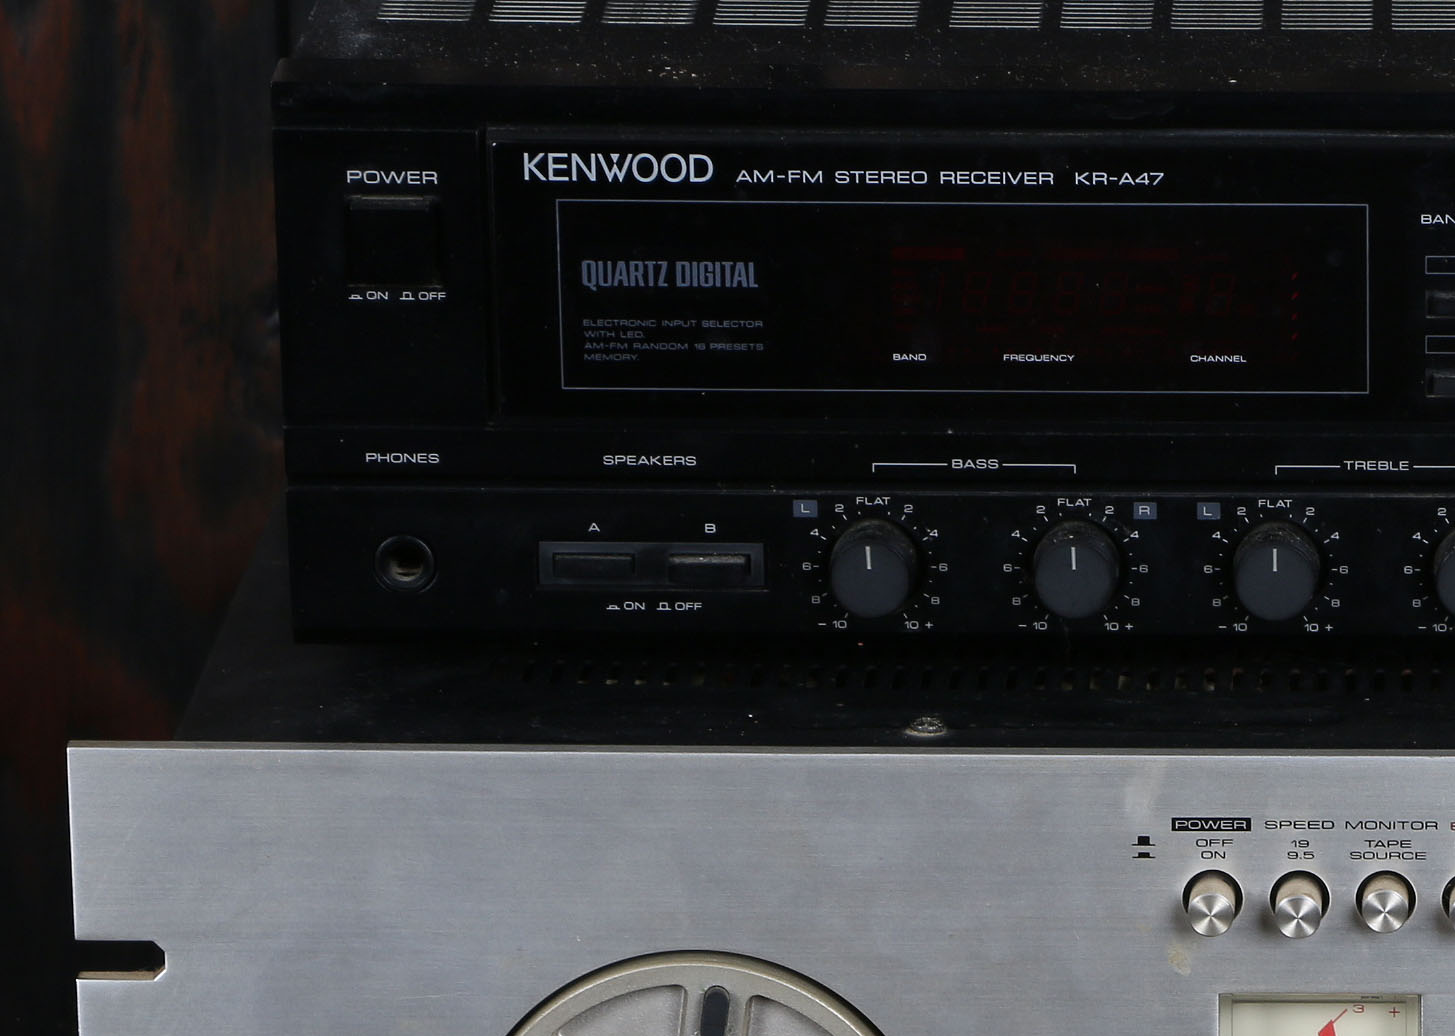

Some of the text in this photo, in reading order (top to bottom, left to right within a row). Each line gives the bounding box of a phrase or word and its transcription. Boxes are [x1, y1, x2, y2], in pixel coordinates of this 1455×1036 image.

[523, 152, 1165, 186] KENWOOD AM-FM STEREO RECEIVER KR-A47
[346, 169, 438, 185] POWER
[581, 259, 759, 292] QUARTZ DIGITAL
[366, 290, 447, 301] ON OFF
[582, 318, 657, 328] ELECTRONIC
[892, 353, 927, 362] BAND
[1003, 353, 1075, 362] FREQUENCY
[1190, 354, 1247, 363] CHANNEL
[365, 452, 440, 464] PHONES
[602, 454, 697, 466] SPEAKERS
[951, 458, 999, 470] BASS
[1343, 460, 1410, 471] TREBLE
[855, 496, 891, 506] FLAT
[1057, 497, 1092, 507] FLAT
[1258, 499, 1293, 508] FLAT
[800, 503, 811, 514] L
[1138, 505, 1151, 516] R
[1202, 505, 1213, 517] L
[588, 522, 601, 532] A
[704, 523, 717, 534] B
[623, 601, 703, 611] ON OFF
[1174, 819, 1248, 830] POWER
[1264, 820, 1335, 830] SPEED
[1344, 820, 1439, 832] MONITOR
[1195, 838, 1234, 848] OFF
[1290, 839, 1310, 850] 19
[1363, 839, 1412, 849] TAPE
[1200, 850, 1226, 860] ON
[1287, 850, 1315, 860] 9.5
[1349, 851, 1427, 861] SOURCE
